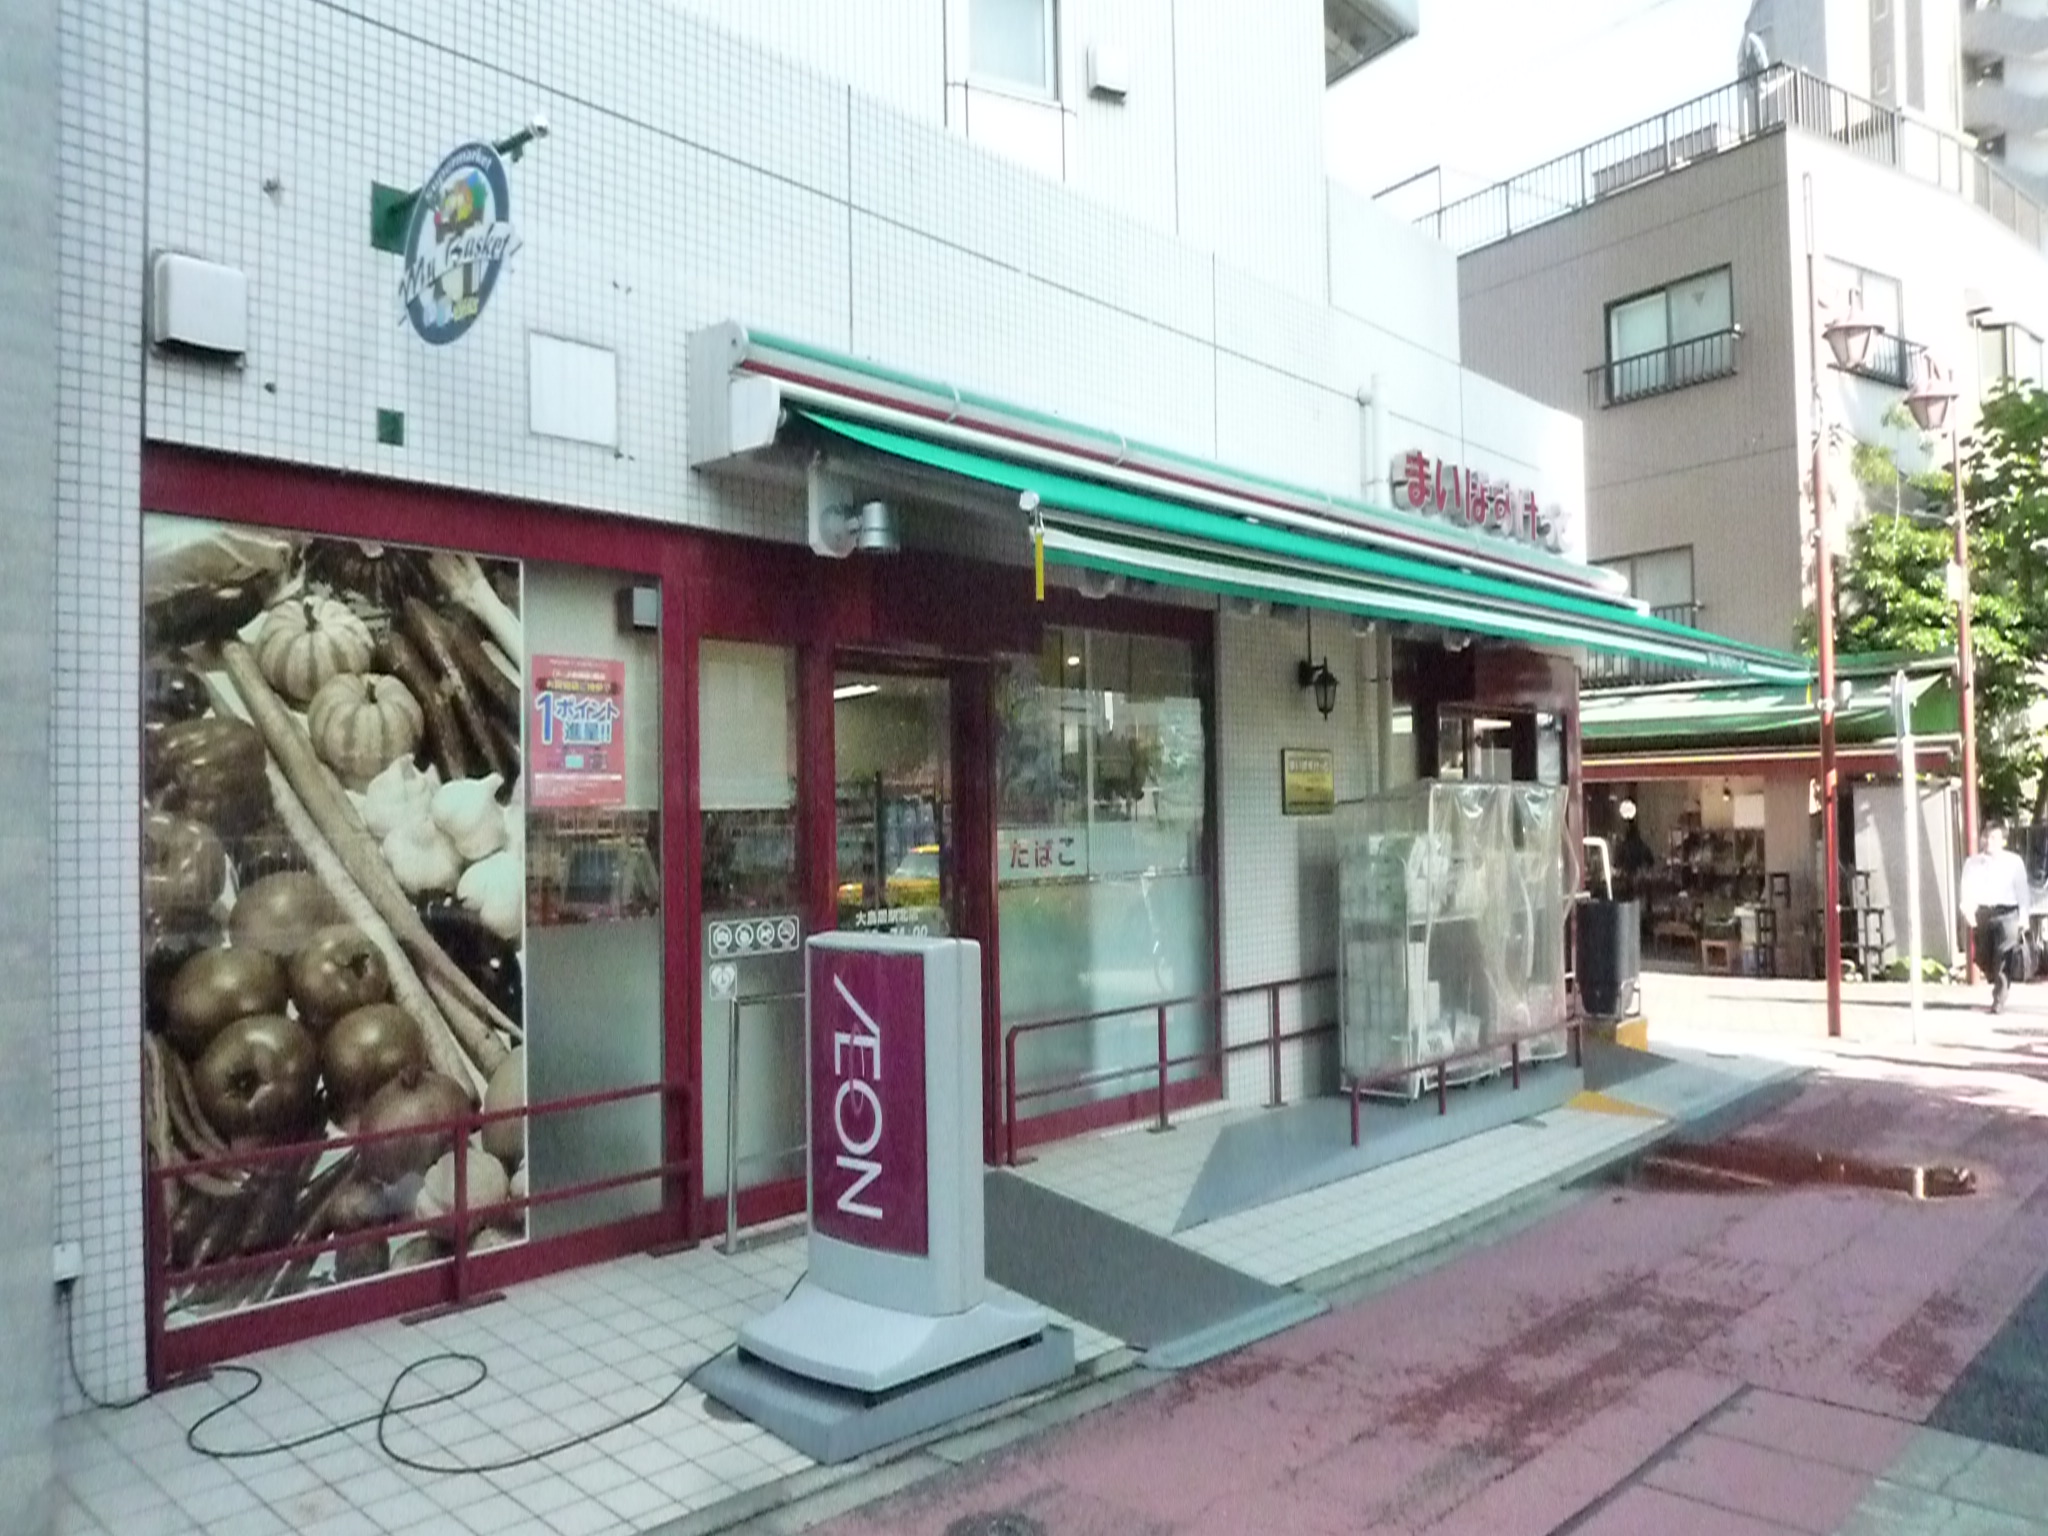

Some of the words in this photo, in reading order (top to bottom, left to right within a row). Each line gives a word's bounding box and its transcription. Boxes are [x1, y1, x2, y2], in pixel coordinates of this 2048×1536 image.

[1010, 836, 1076, 869] たばこ
[833, 972, 884, 1220] AEON
